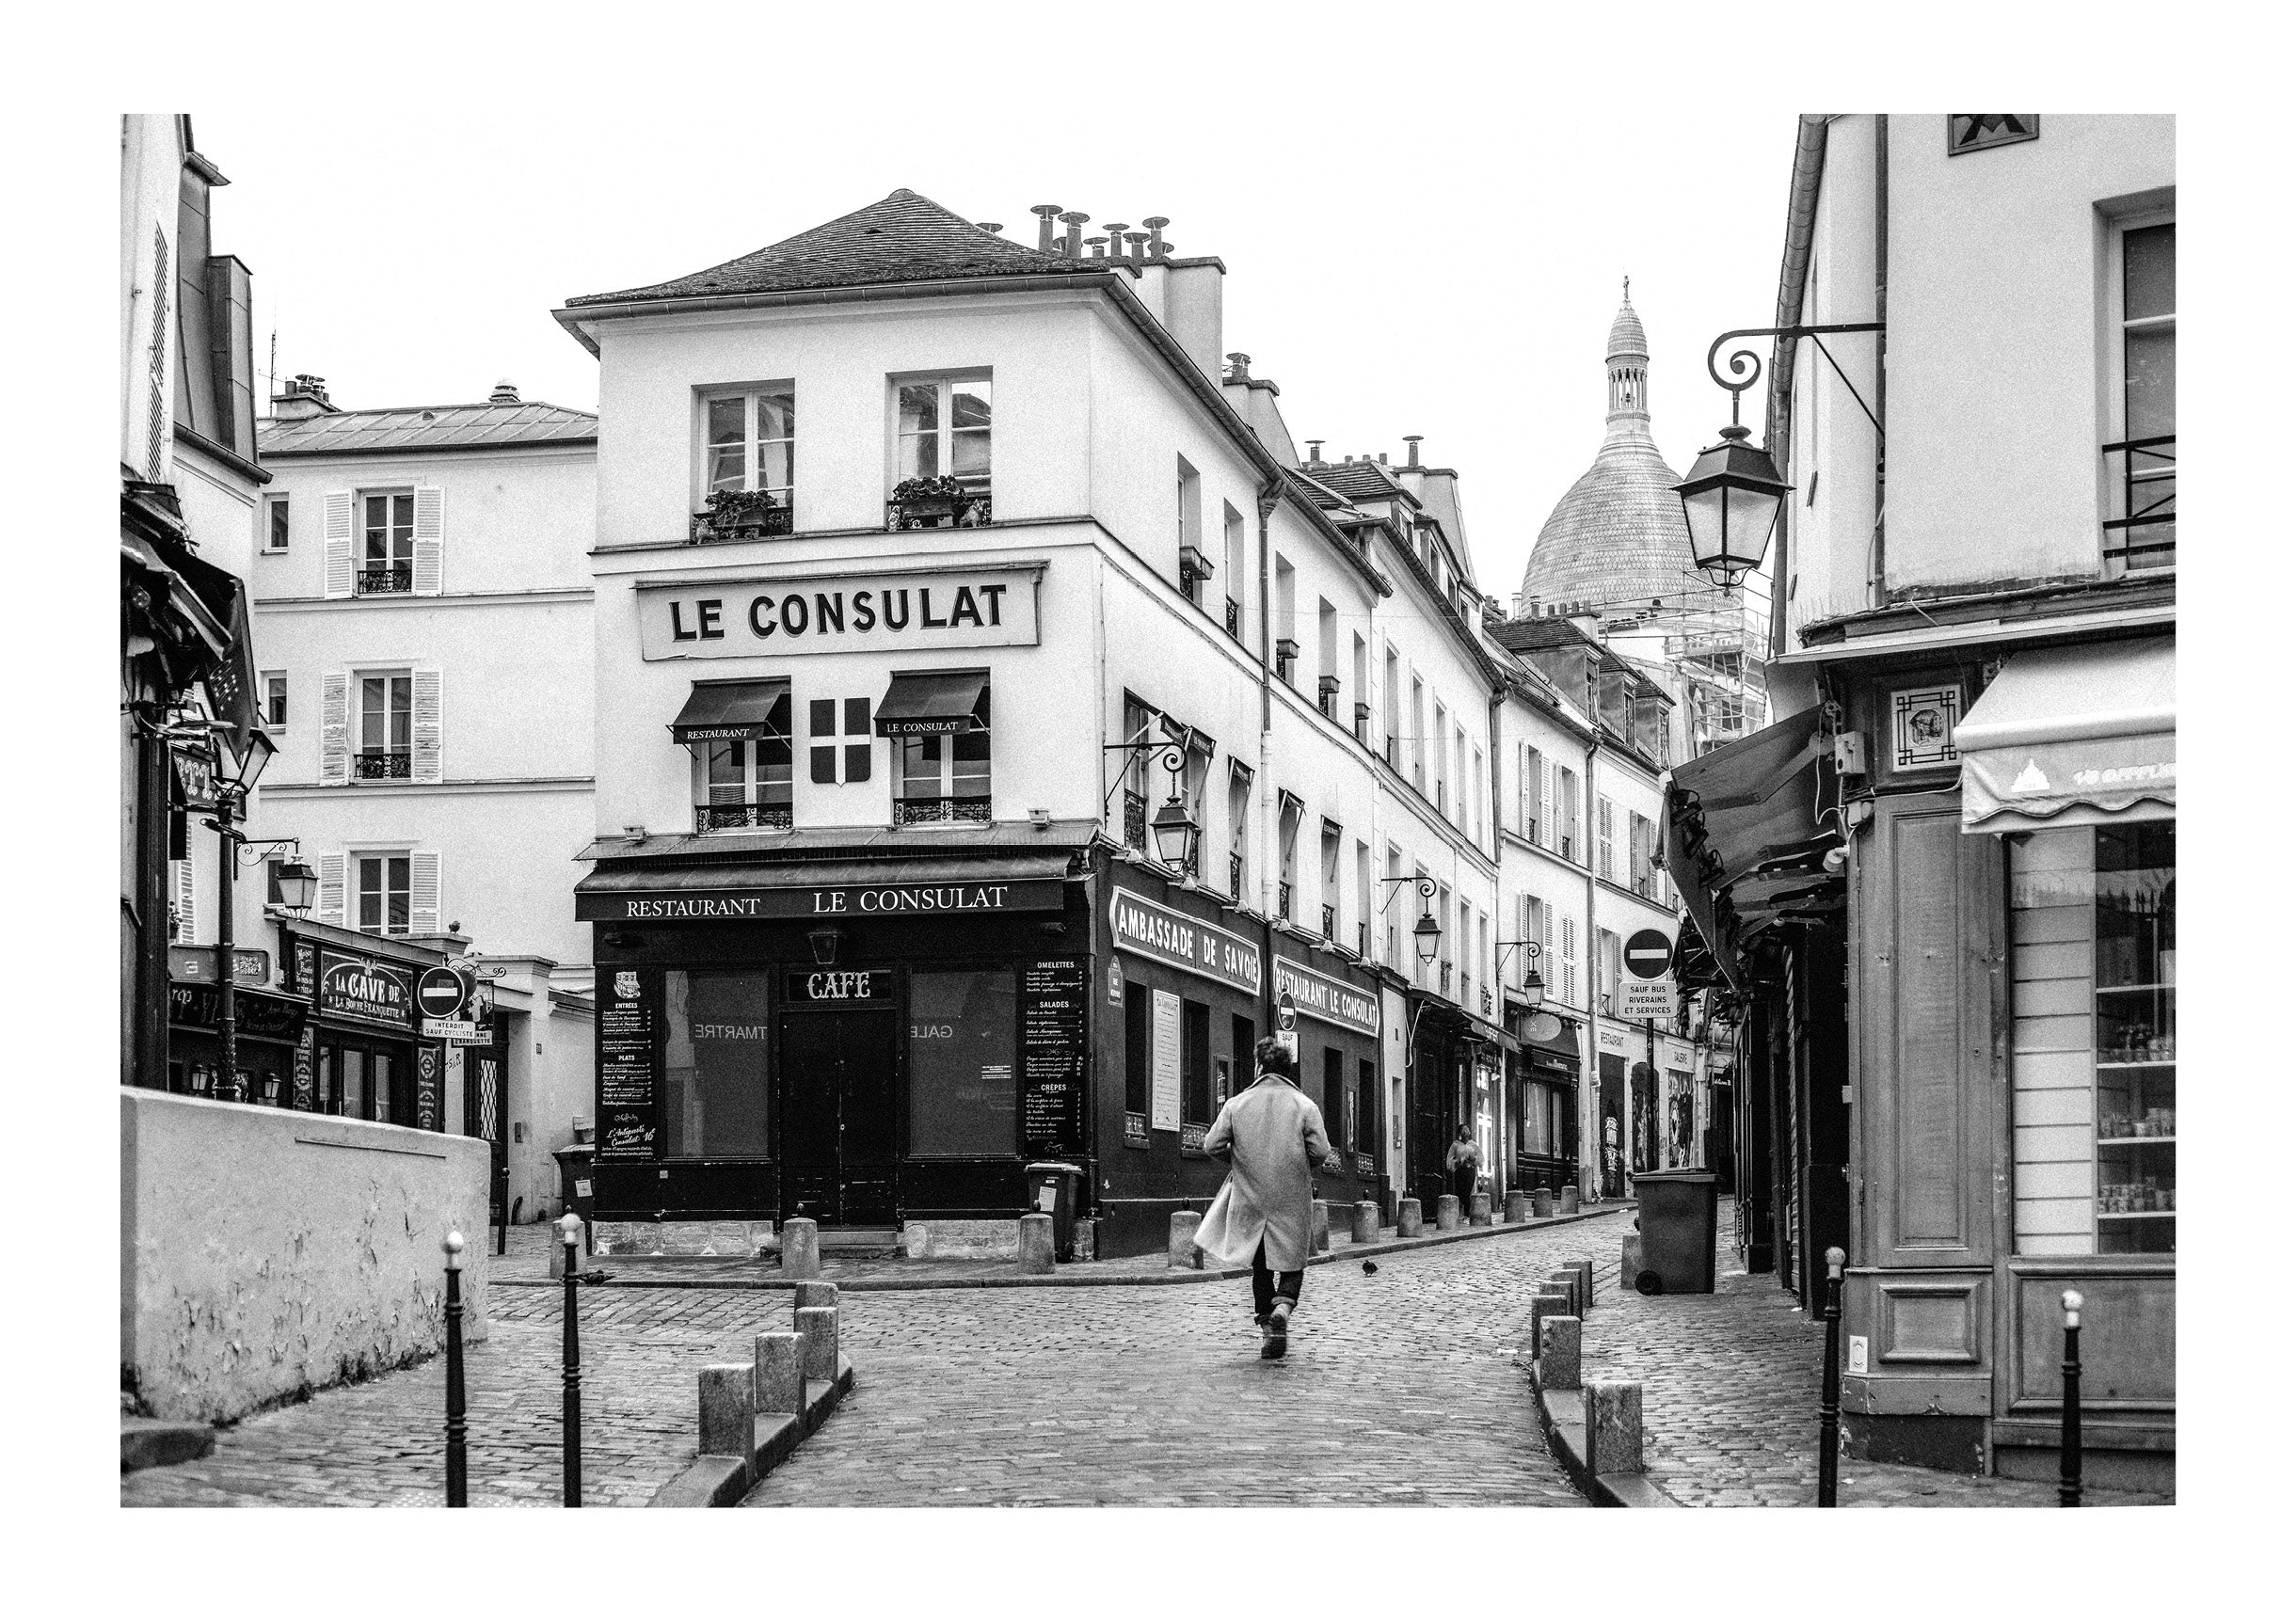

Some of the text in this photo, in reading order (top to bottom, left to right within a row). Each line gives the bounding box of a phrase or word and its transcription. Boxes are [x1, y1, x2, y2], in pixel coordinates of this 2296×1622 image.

[669, 583, 1007, 642] LE CONSULAT
[686, 727, 750, 740] RESTAURANT
[886, 721, 958, 733] LE CONSULAT
[814, 885, 1009, 914] LE CONSULAT
[626, 898, 760, 918] RESTAURANT
[1118, 904, 1258, 984] AMBASSADE DE SAVOIE
[1037, 961, 1075, 969] OMELETTES
[336, 972, 400, 1004] LA CAVE DE
[806, 972, 871, 999] CAFE
[335, 995, 344, 1008] LA
[1275, 967, 1376, 1027] RESTAURANT LE CONSULAT
[1629, 995, 1667, 1004] RIVERAINS
[1039, 1000, 1070, 1009] SALADES
[1635, 1006, 1671, 1014] SERVICES
[1041, 1083, 1067, 1091] CRÊPES
